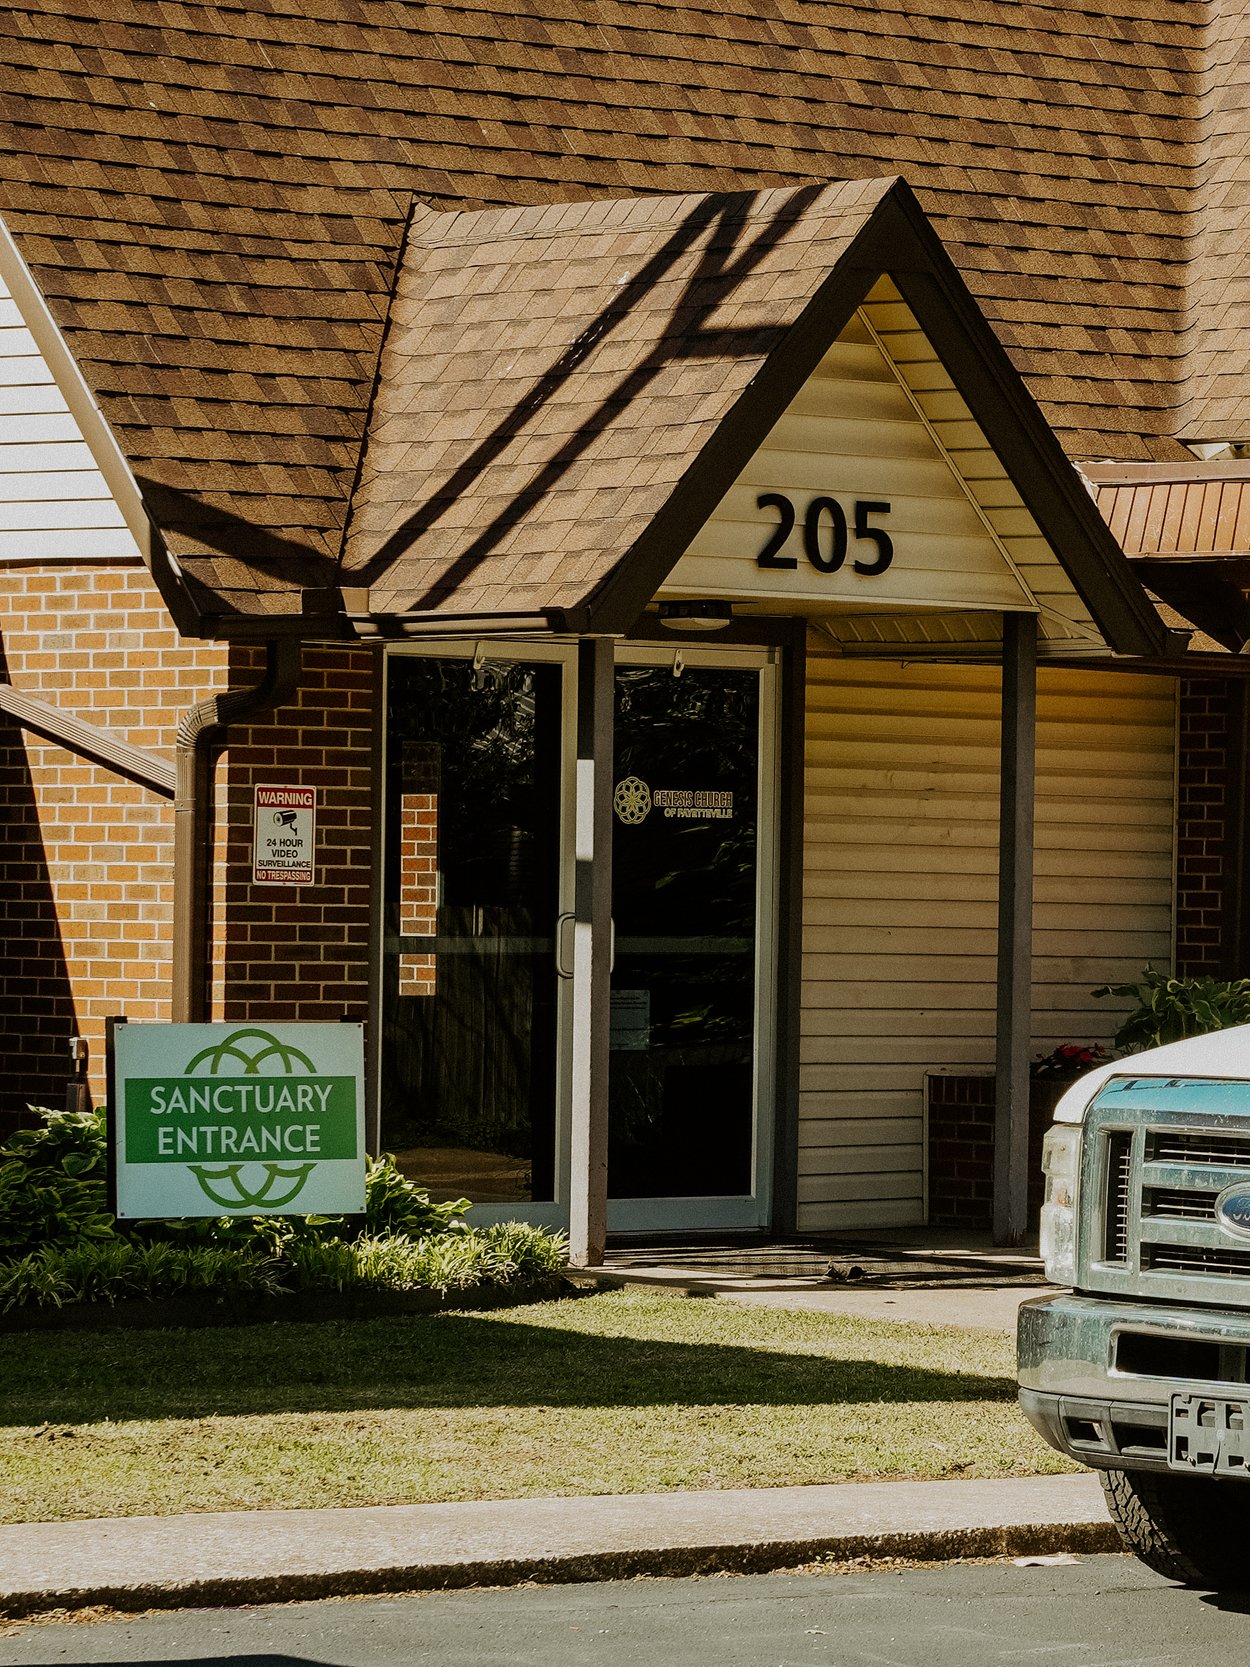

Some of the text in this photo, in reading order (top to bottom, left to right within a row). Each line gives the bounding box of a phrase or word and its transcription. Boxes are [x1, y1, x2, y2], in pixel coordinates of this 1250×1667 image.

[756, 493, 894, 576] 205
[258, 791, 313, 806] WARNING
[653, 790, 733, 808] GENESIS CHURCH
[664, 808, 733, 819] OF FAYETTEVILLE
[266, 838, 304, 848] 24 HOUR
[271, 849, 299, 858] VIDEO
[258, 860, 311, 868] SURVEILLANCE
[256, 870, 311, 881] NO TRESPASSING
[150, 1084, 333, 1115] SANCTUARY
[158, 1124, 321, 1155] ENTRANCE
